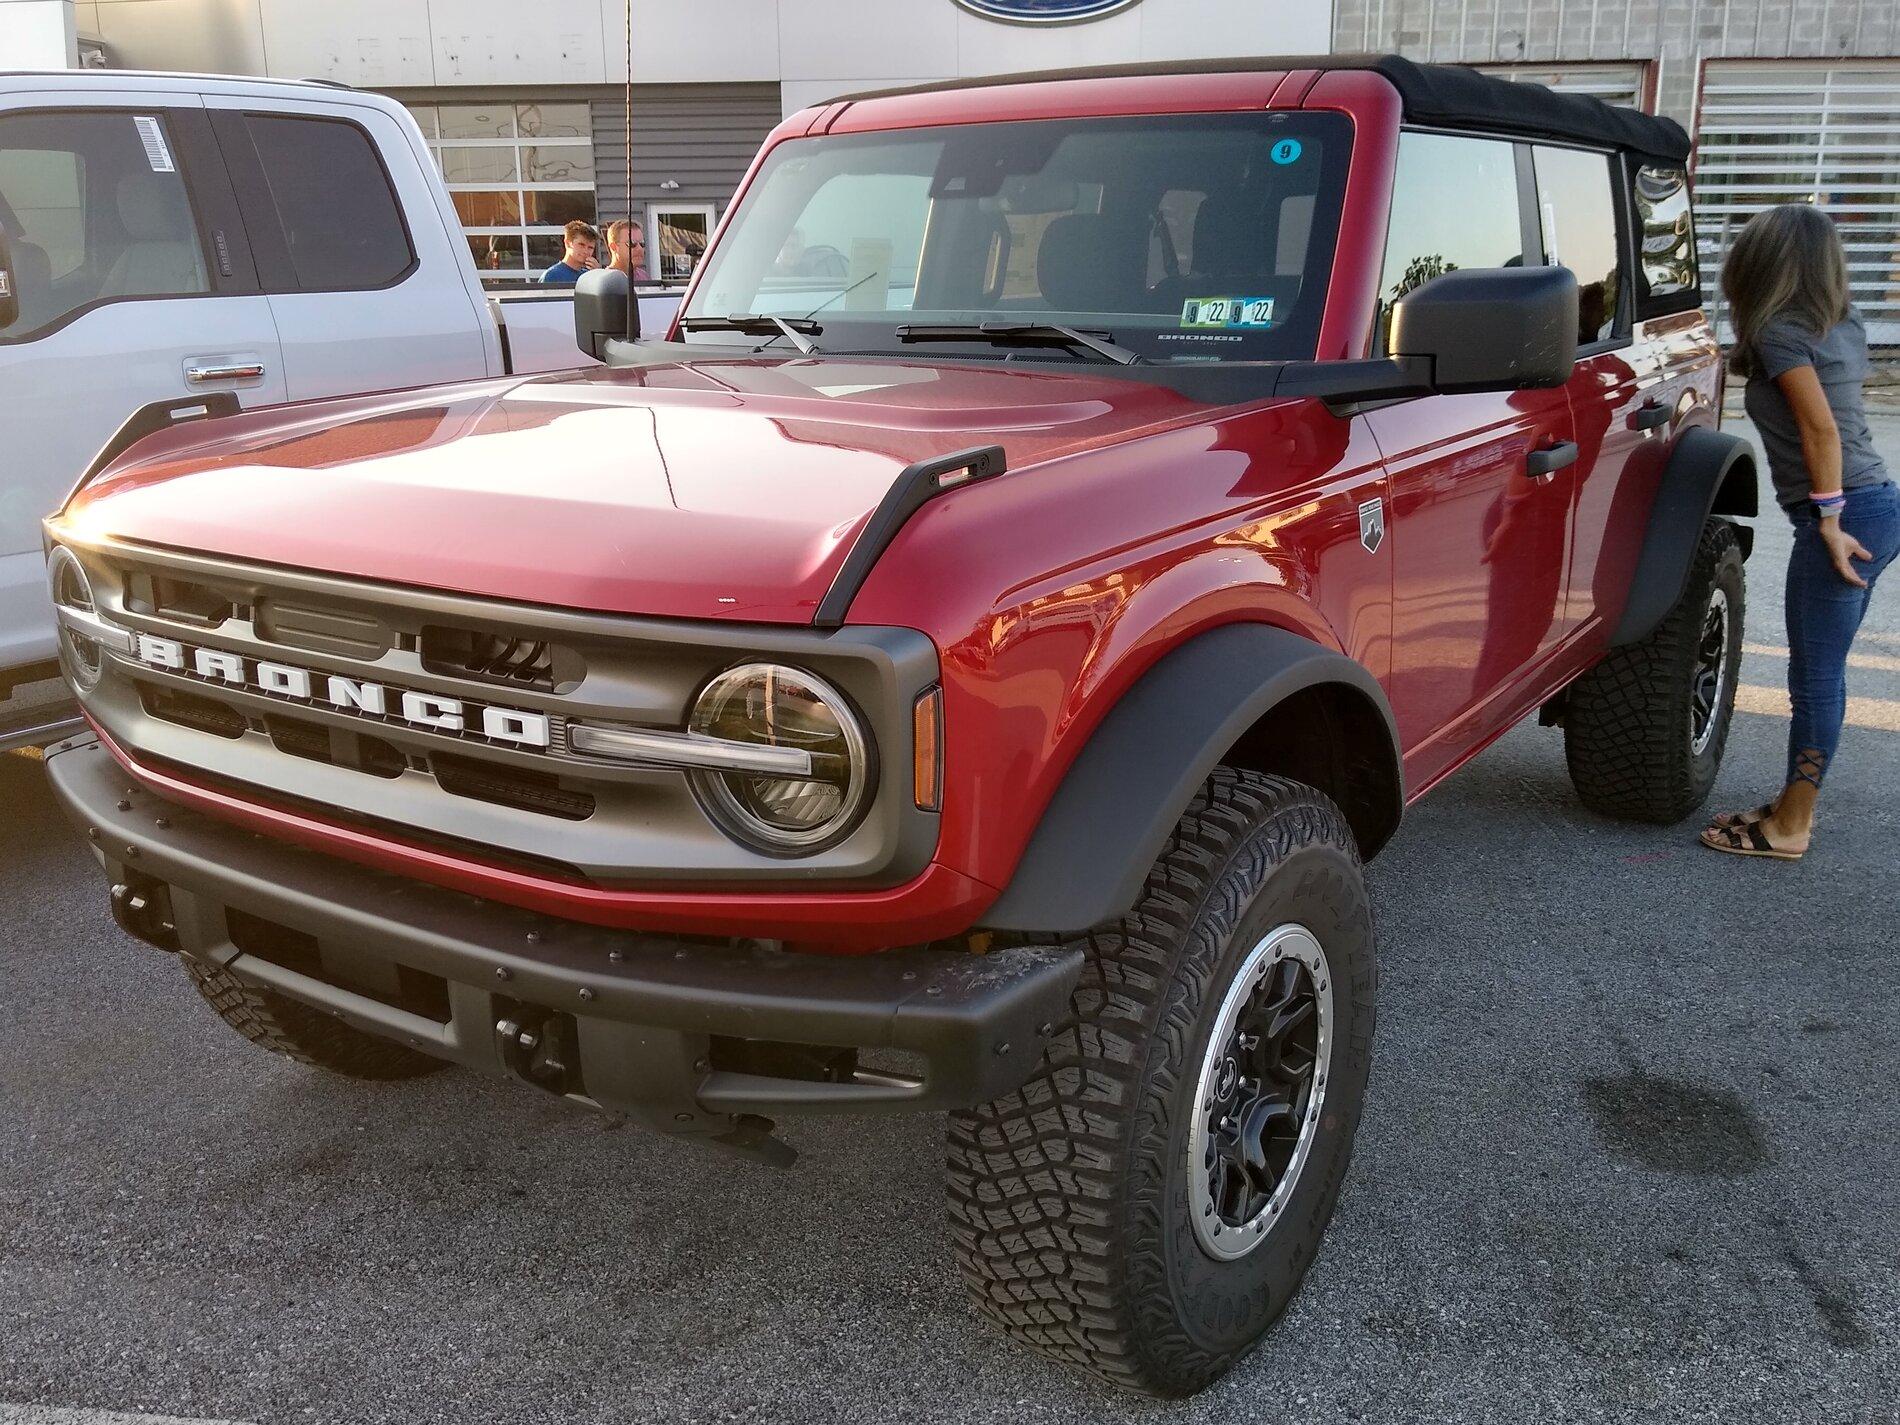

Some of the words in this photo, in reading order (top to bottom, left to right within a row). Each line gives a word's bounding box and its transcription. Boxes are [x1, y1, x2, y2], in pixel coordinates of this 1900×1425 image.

[1280, 144, 1292, 159] 9
[1209, 302, 1225, 322] 22
[1254, 302, 1270, 322] 22
[139, 632, 551, 747] BRONCO
